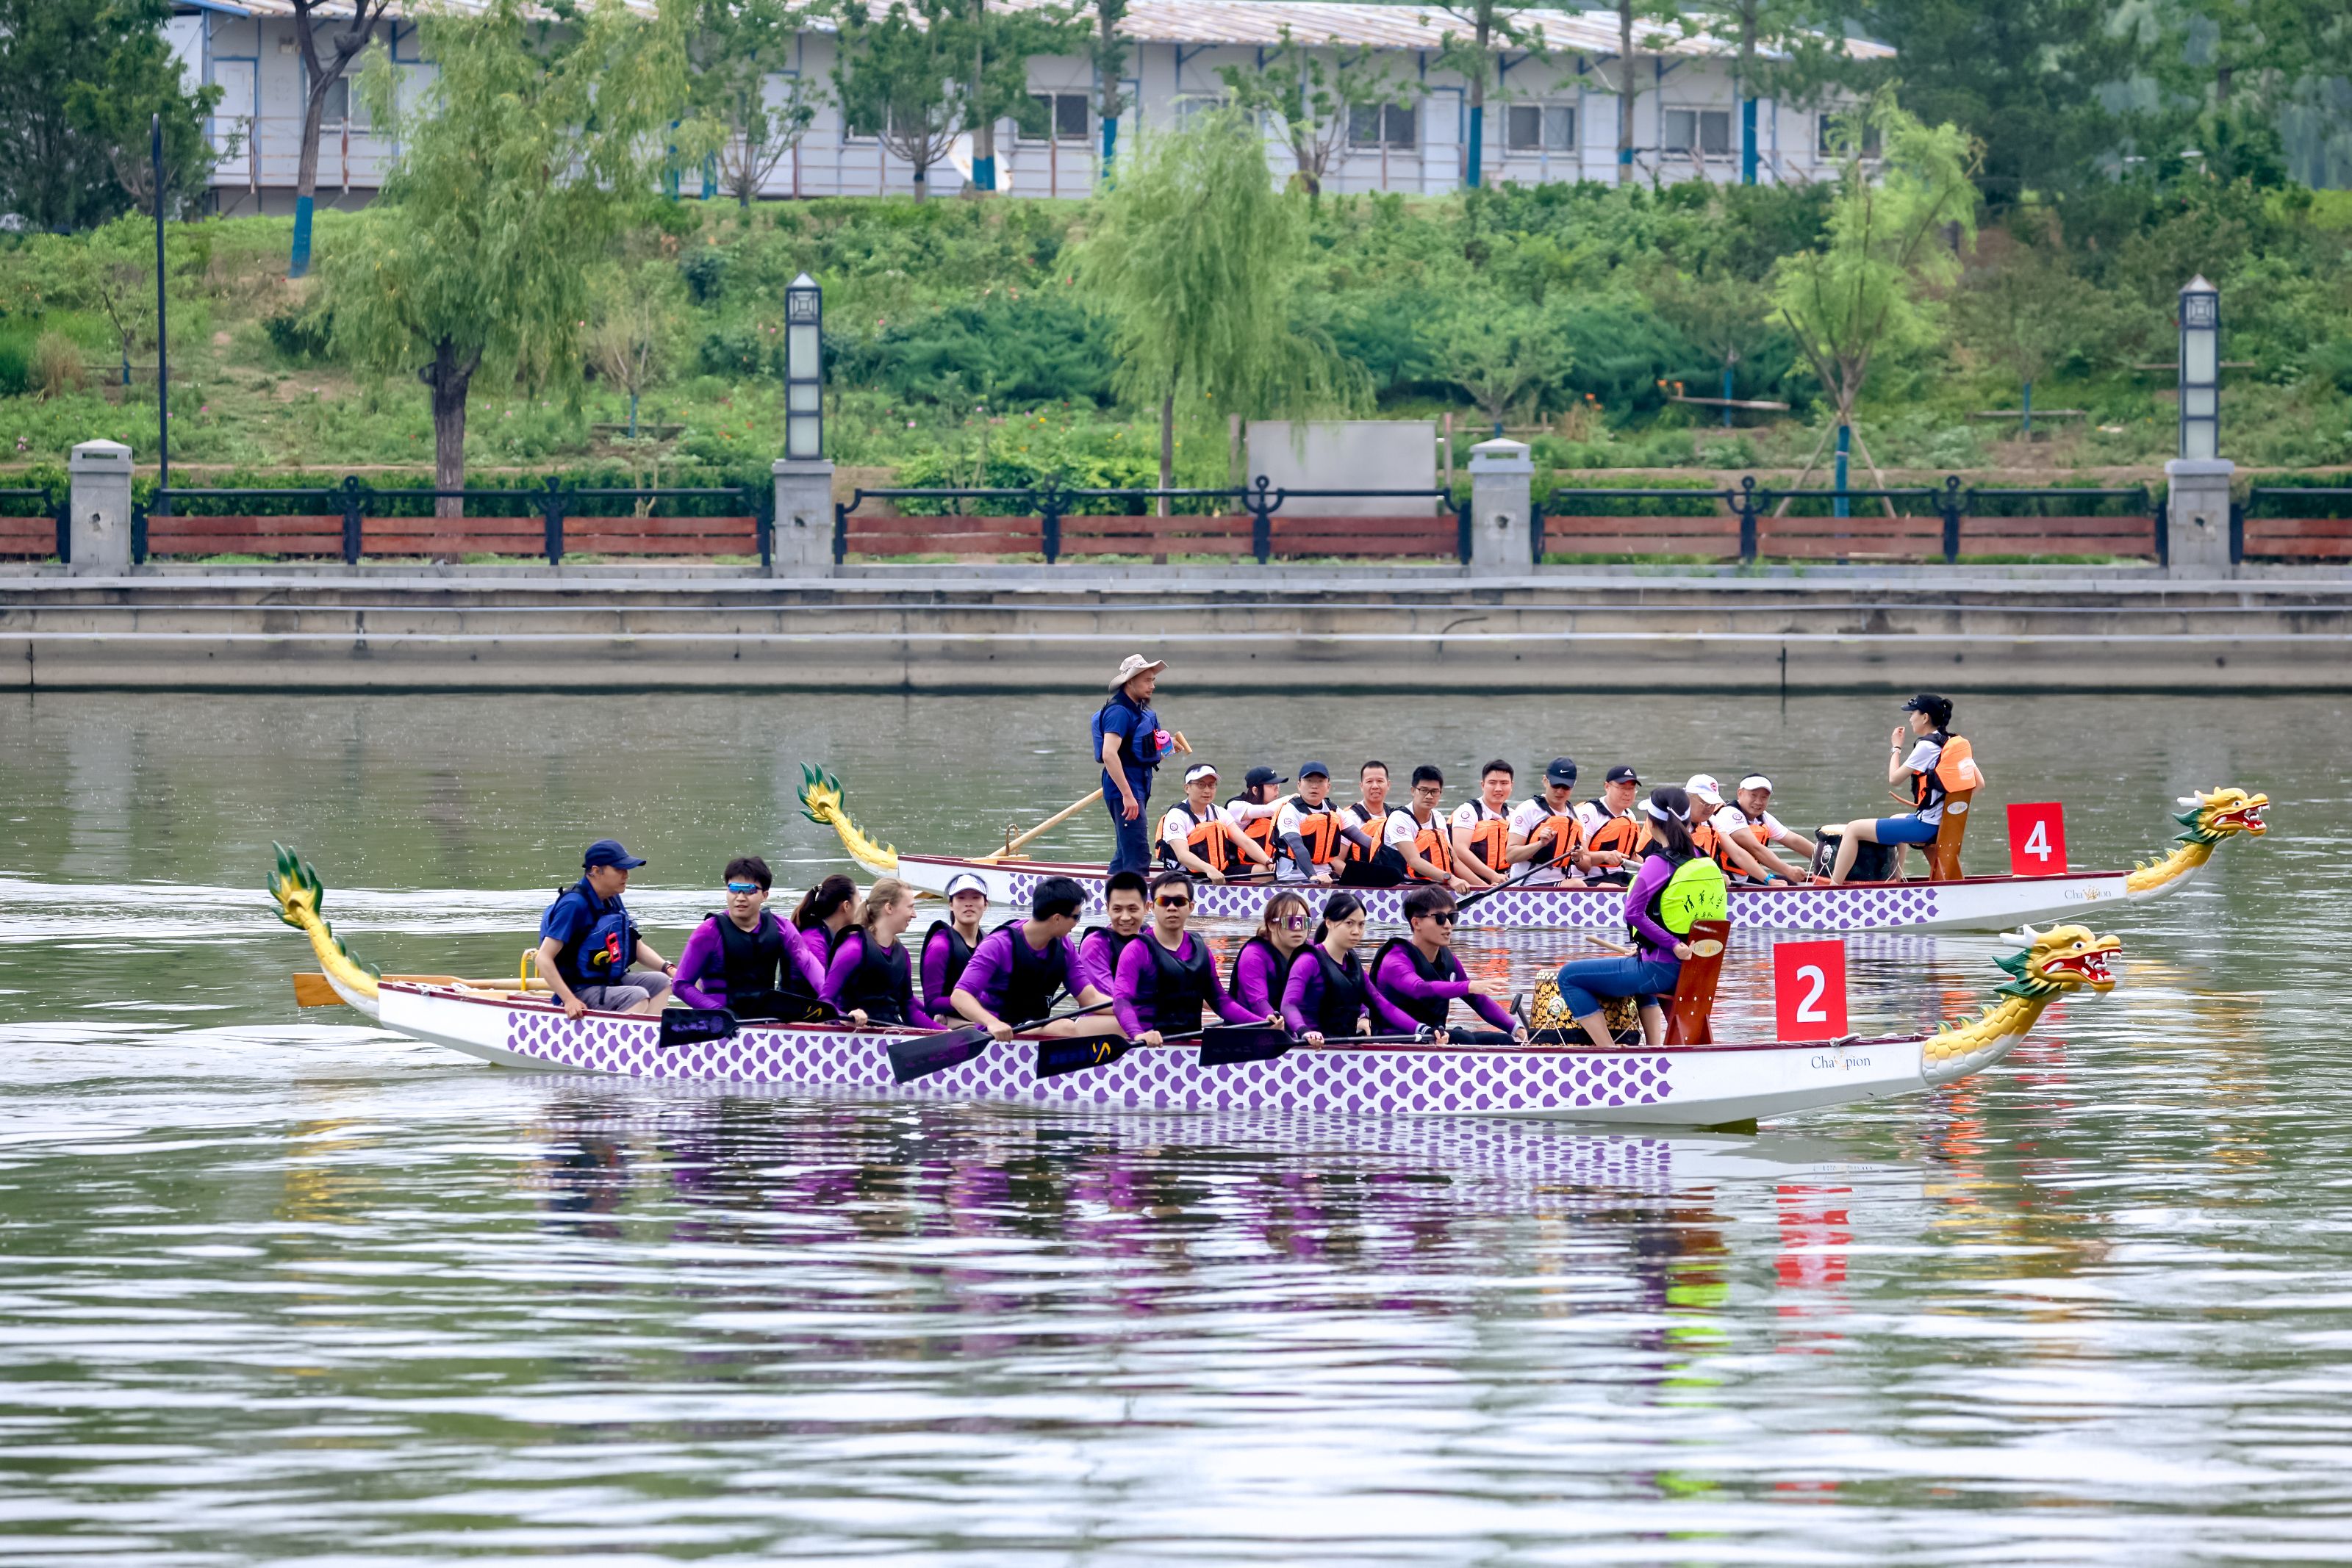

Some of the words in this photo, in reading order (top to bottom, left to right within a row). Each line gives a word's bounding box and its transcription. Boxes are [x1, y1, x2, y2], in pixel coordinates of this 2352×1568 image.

[2024, 820, 2052, 862] 4
[2065, 888, 2112, 901] Chaion
[1796, 965, 1826, 1023] 2
[1811, 1055, 1871, 1071] Chapion
